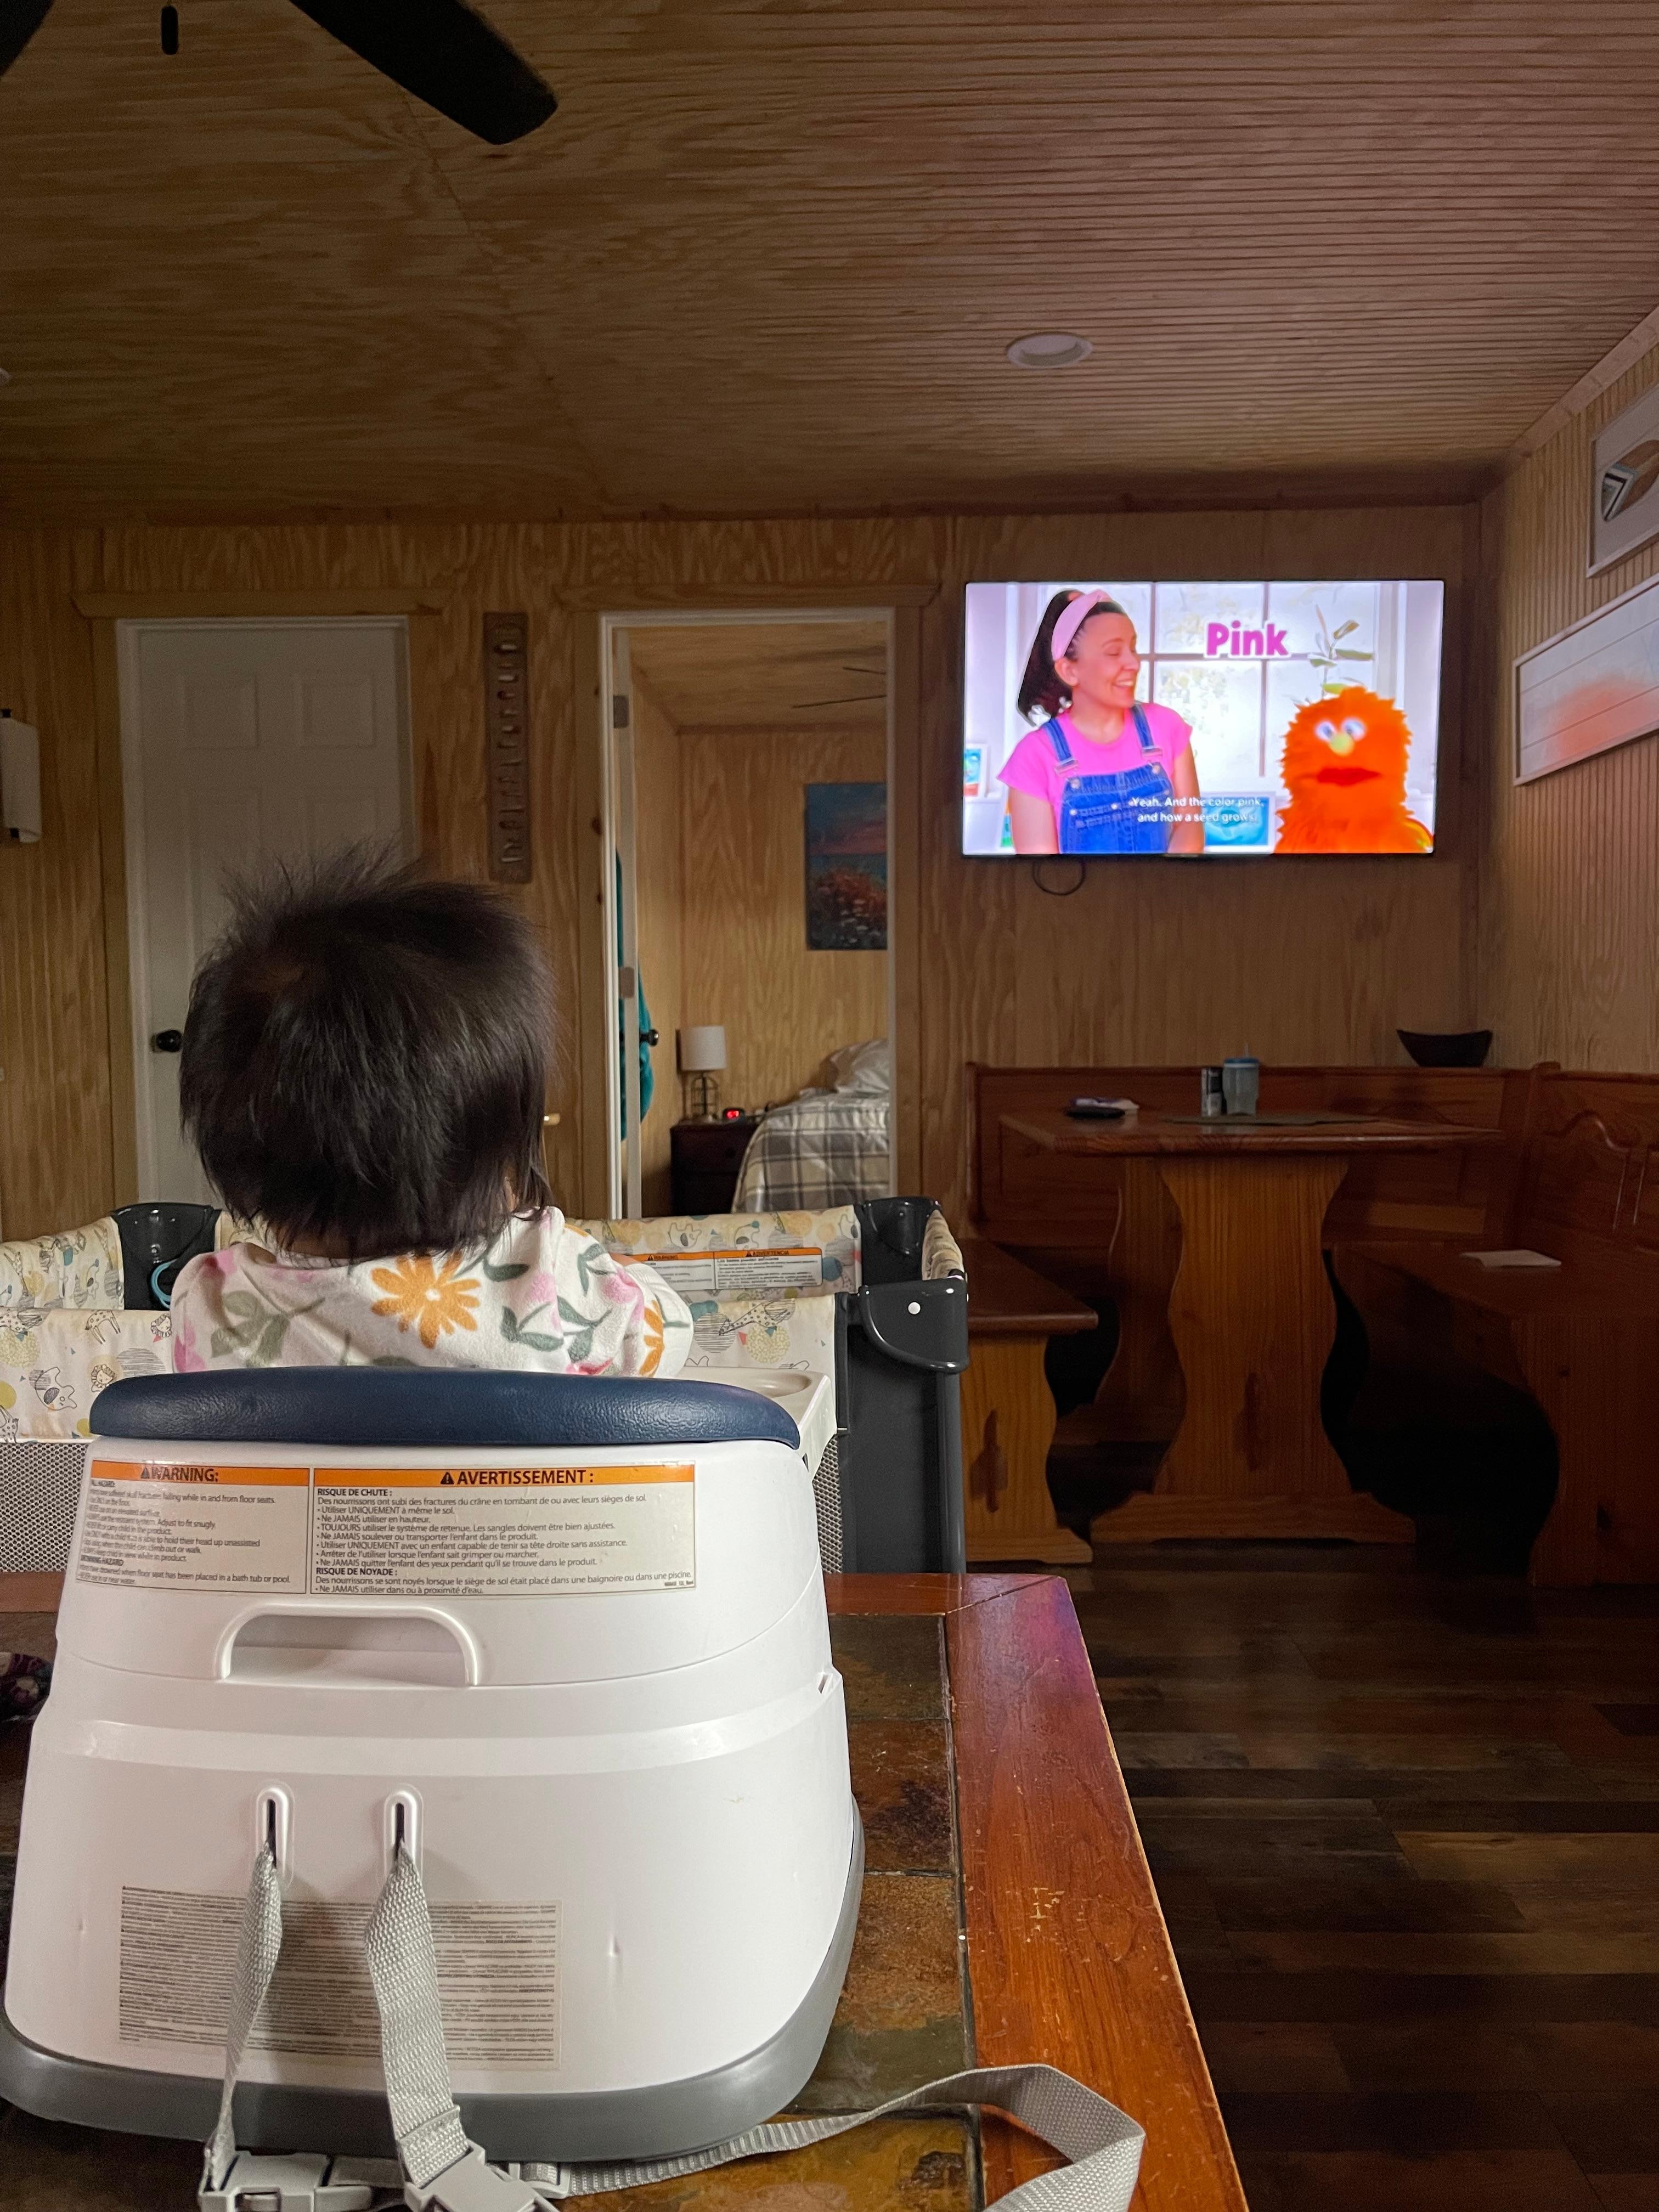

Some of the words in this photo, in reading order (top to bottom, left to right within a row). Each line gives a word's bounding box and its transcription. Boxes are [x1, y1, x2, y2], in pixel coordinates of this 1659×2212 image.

[1206, 619, 1289, 656] Pink
[1132, 797, 1162, 807] Yeah.
[1165, 797, 1186, 807] And
[1189, 797, 1206, 807] the
[1209, 797, 1234, 807] color
[1137, 812, 1158, 822] and
[1160, 812, 1183, 822] how
[1194, 812, 1219, 822] seed
[151, 1466, 219, 1482] WARNING:
[456, 1470, 586, 1485] AVERTISSEMENT
[318, 1488, 346, 1497] RISQUE
[239, 1495, 255, 1503] floor
[424, 1497, 456, 1505] fractures
[601, 1495, 623, 1504] sièges
[397, 1524, 427, 1533] système
[487, 1524, 516, 1533] sangles
[584, 1521, 615, 1531] ajustées.
[407, 1533, 448, 1542] transporter
[508, 1533, 538, 1542] produit.
[458, 1543, 487, 1551] capable
[589, 1539, 628, 1548] assistance.
[388, 1551, 416, 1559] lorsque
[461, 1551, 492, 1560] grimper
[361, 1559, 386, 1568] quitter
[451, 1560, 483, 1568] pendant
[567, 1558, 597, 1567] produit.
[403, 1578, 425, 1587] noyés
[426, 1578, 454, 1586] lorsque
[465, 1578, 484, 1587] siège
[529, 1577, 549, 1586] placé
[588, 1575, 623, 1584] baignoire
[668, 1571, 692, 1580] piscine.
[424, 1586, 460, 1595] proximité
